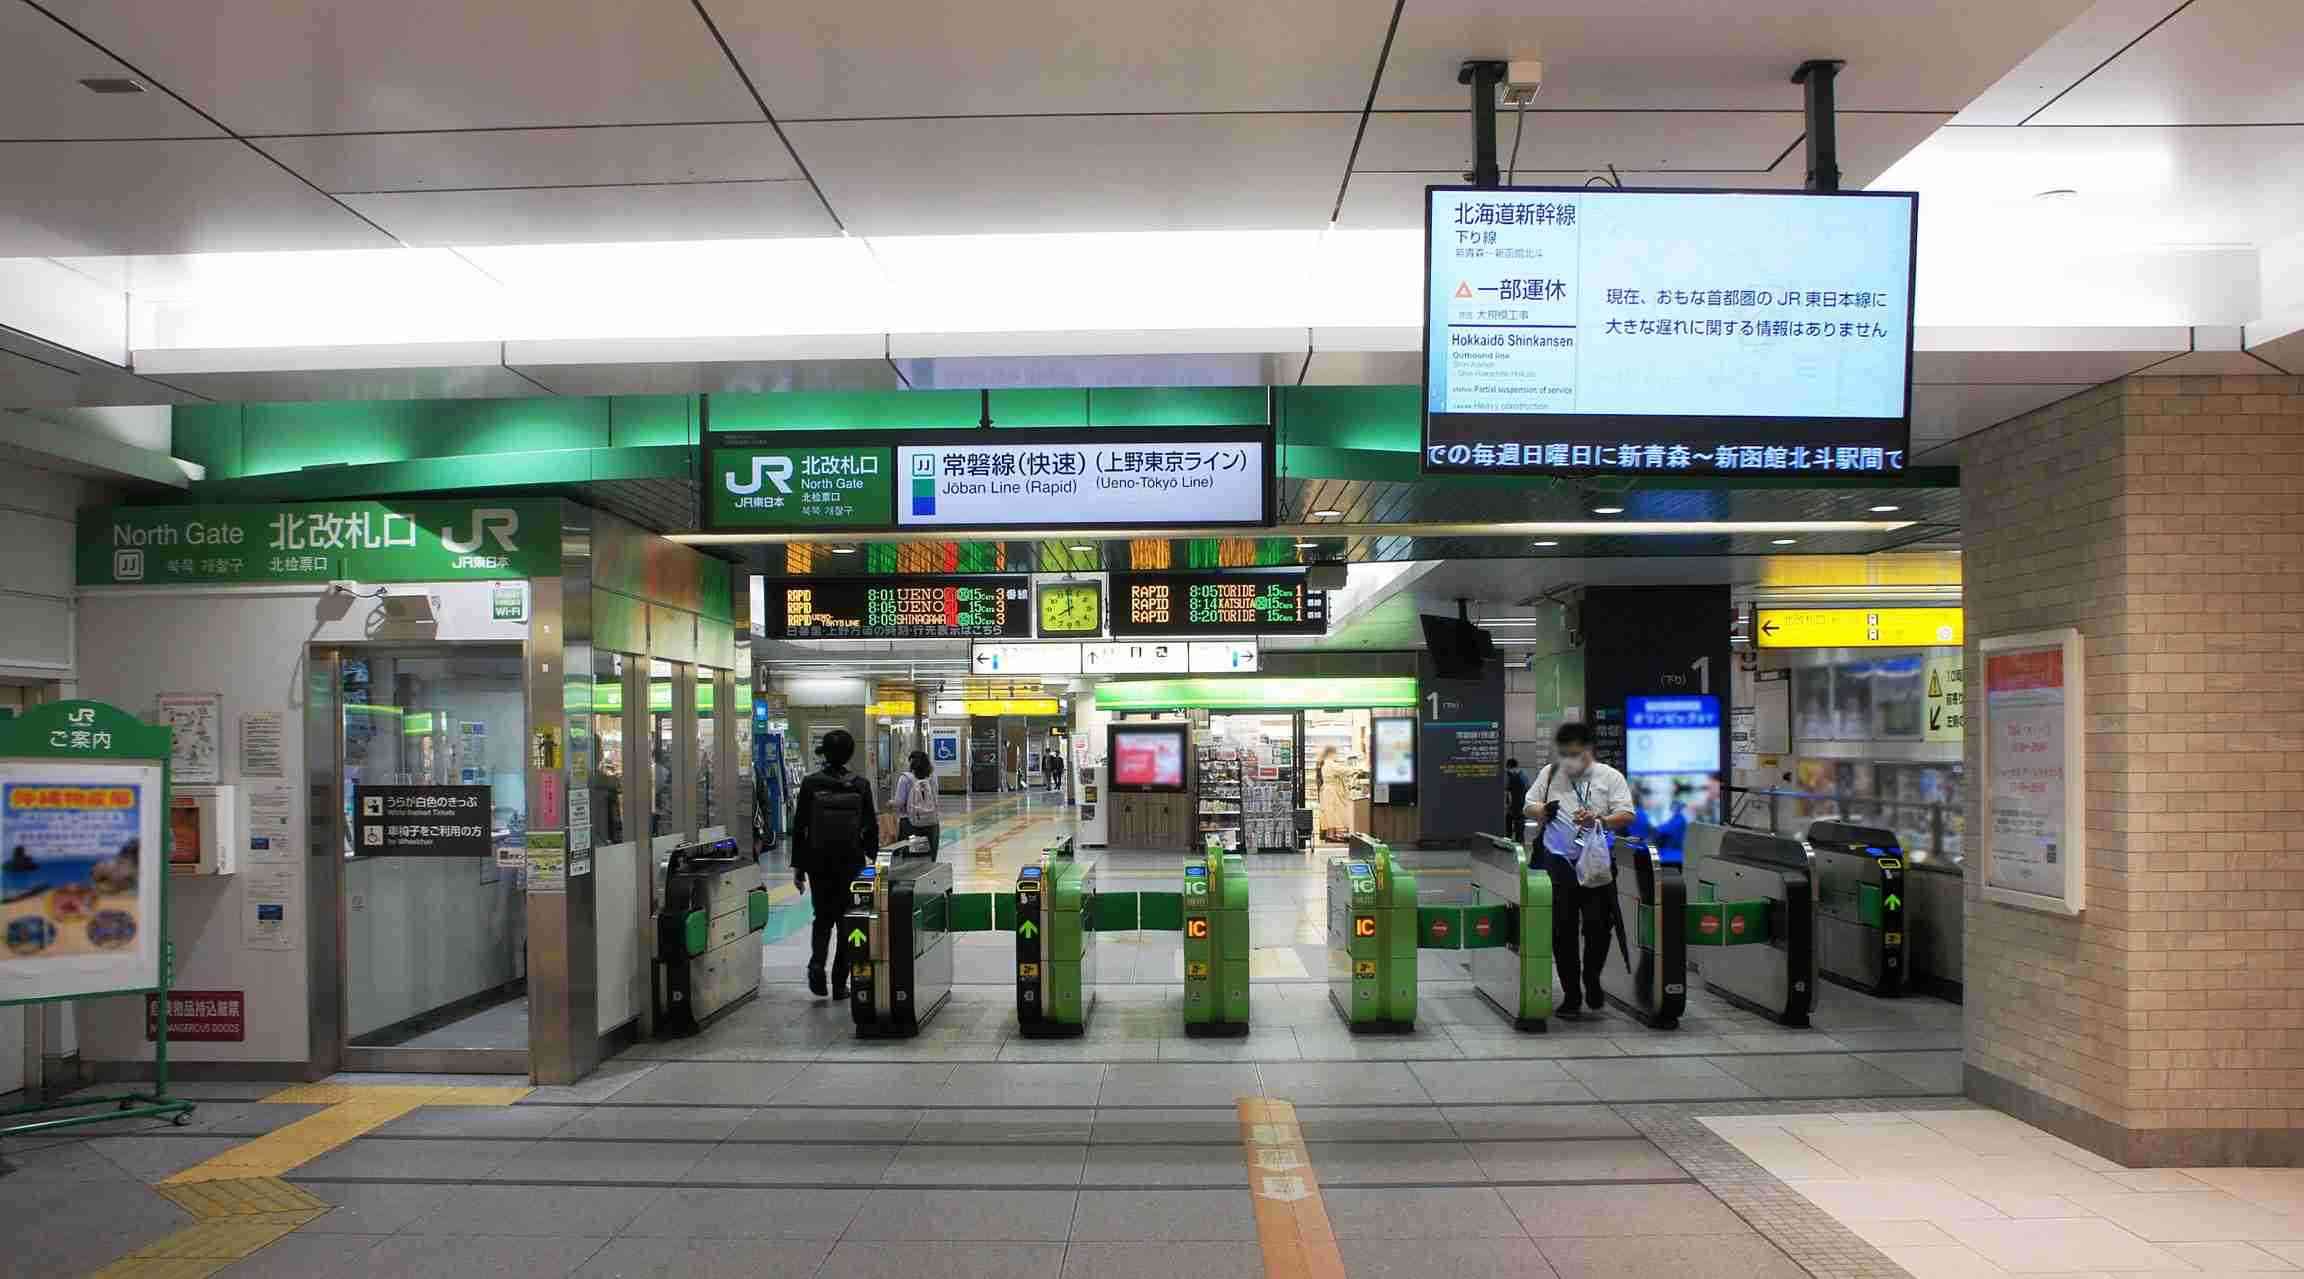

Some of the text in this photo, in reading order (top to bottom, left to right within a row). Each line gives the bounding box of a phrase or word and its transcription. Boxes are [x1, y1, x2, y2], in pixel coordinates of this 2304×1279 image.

[1454, 202, 1576, 226] 北海道新幹線
[1455, 230, 1497, 245] 下り線
[1477, 278, 1567, 301] 一部運休
[1605, 319, 1888, 339] 大きな遅れに関する情報はありません
[1507, 334, 1574, 348] Shinkansen
[801, 455, 878, 475] 北改札口
[725, 456, 794, 495] JR
[1181, 474, 1214, 489] Line)
[801, 478, 864, 490] North Gate
[991, 480, 1021, 494] Line
[1025, 478, 1077, 496] (Rapid)
[735, 496, 785, 509] JR東日本
[114, 521, 245, 546] North Gate
[269, 512, 417, 550] 北改札口
[441, 508, 519, 553] JR
[452, 555, 511, 570] JR東日本
[787, 589, 811, 602] RAPID
[868, 588, 893, 601] 8:01
[897, 588, 944, 601] UENO
[996, 588, 1005, 601] 3
[1131, 586, 1169, 598] RAPID
[1189, 585, 1218, 598] 8:05
[1218, 585, 1255, 598] TORIDE
[1296, 585, 1303, 597] 1
[787, 601, 811, 614] RAPID
[868, 601, 896, 614] 8:05
[897, 601, 944, 613] UENO
[996, 601, 1005, 613] 3
[1131, 598, 1169, 610] RAPID
[1189, 597, 1217, 610] 8:14
[1296, 597, 1303, 610] 1
[787, 614, 811, 626] RAPID
[868, 613, 896, 626] 8:09
[996, 613, 1005, 625] 3
[1131, 611, 1169, 623] RAPID
[1189, 610, 1218, 622] 8:20
[1217, 610, 1255, 622] TORIDE
[1296, 610, 1303, 622] 1
[1690, 656, 1710, 695] 1
[1426, 691, 1439, 721] 1
[68, 707, 96, 723] JR
[50, 730, 113, 750] ご案内
[1185, 881, 1208, 897] IC
[1353, 879, 1376, 894] IC
[1187, 920, 1207, 937] IC
[1356, 919, 1375, 936] IC
